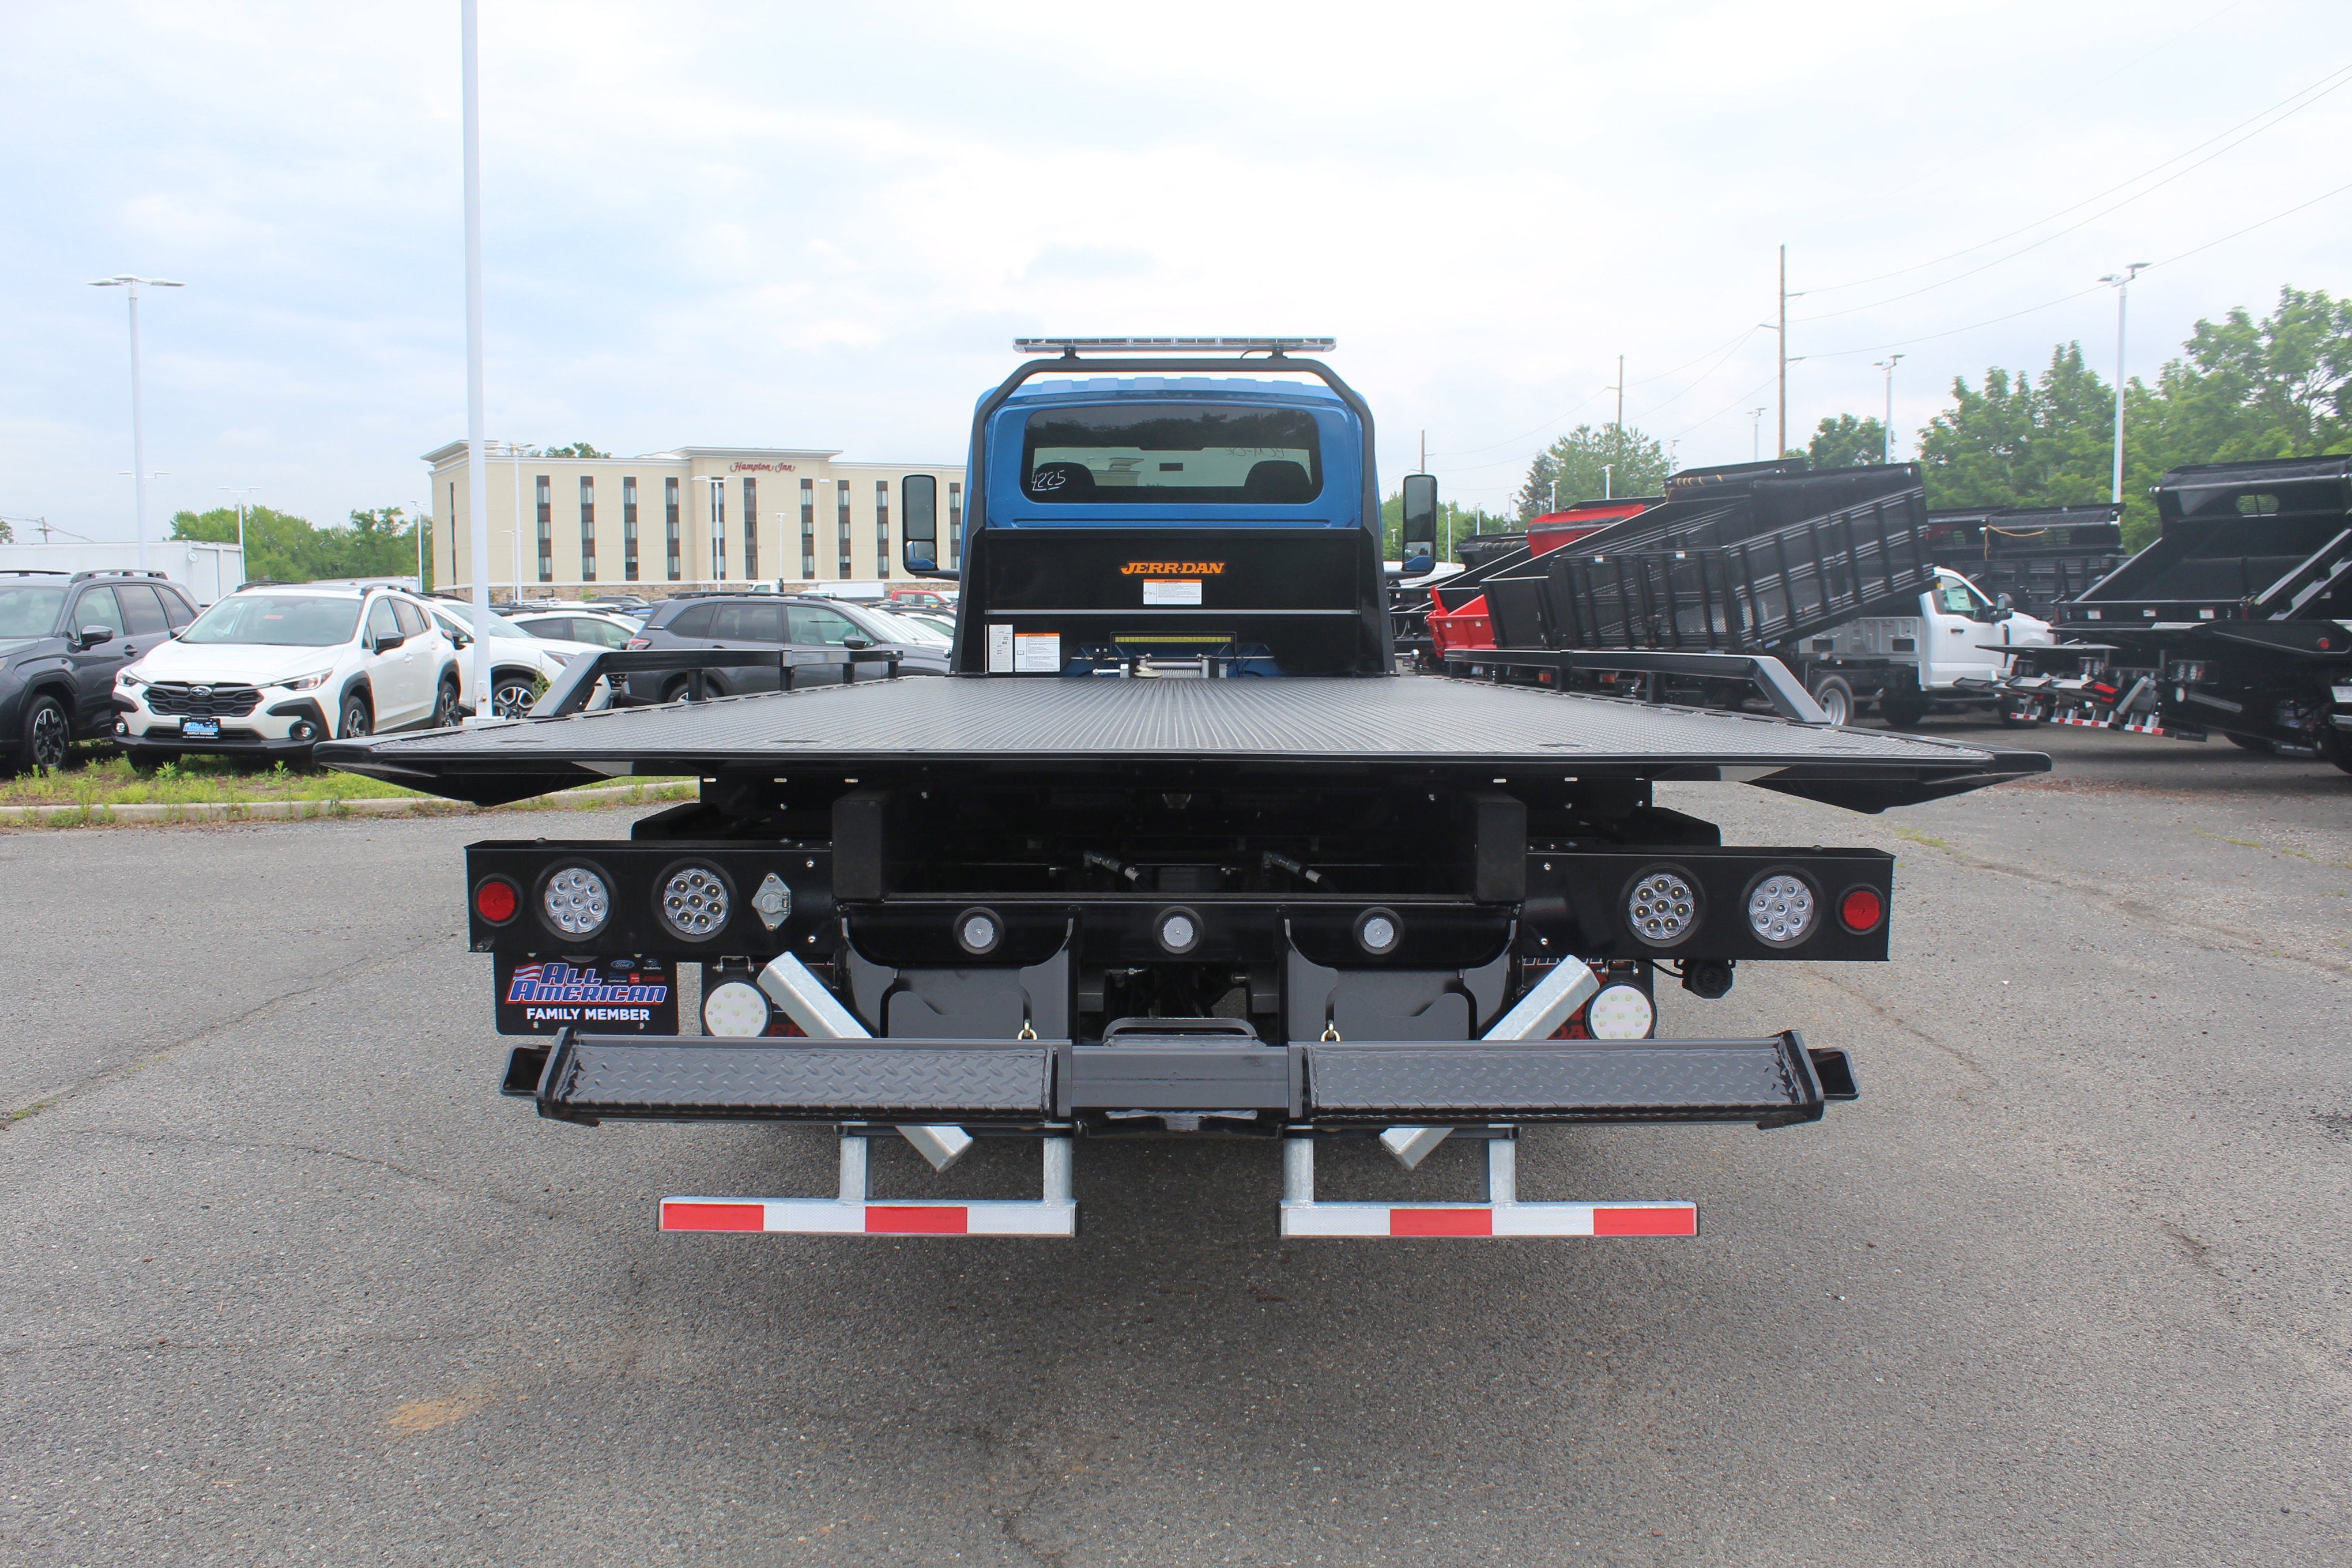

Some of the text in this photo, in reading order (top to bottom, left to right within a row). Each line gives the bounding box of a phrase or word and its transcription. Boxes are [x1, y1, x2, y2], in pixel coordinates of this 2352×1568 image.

[730, 462, 796, 472] Hampton Inn
[1121, 562, 1224, 574] JERR-DAN
[541, 963, 602, 985] ALL
[508, 979, 667, 1002] AMERICAN
[527, 1008, 650, 1021] FAMILY MEMBER
